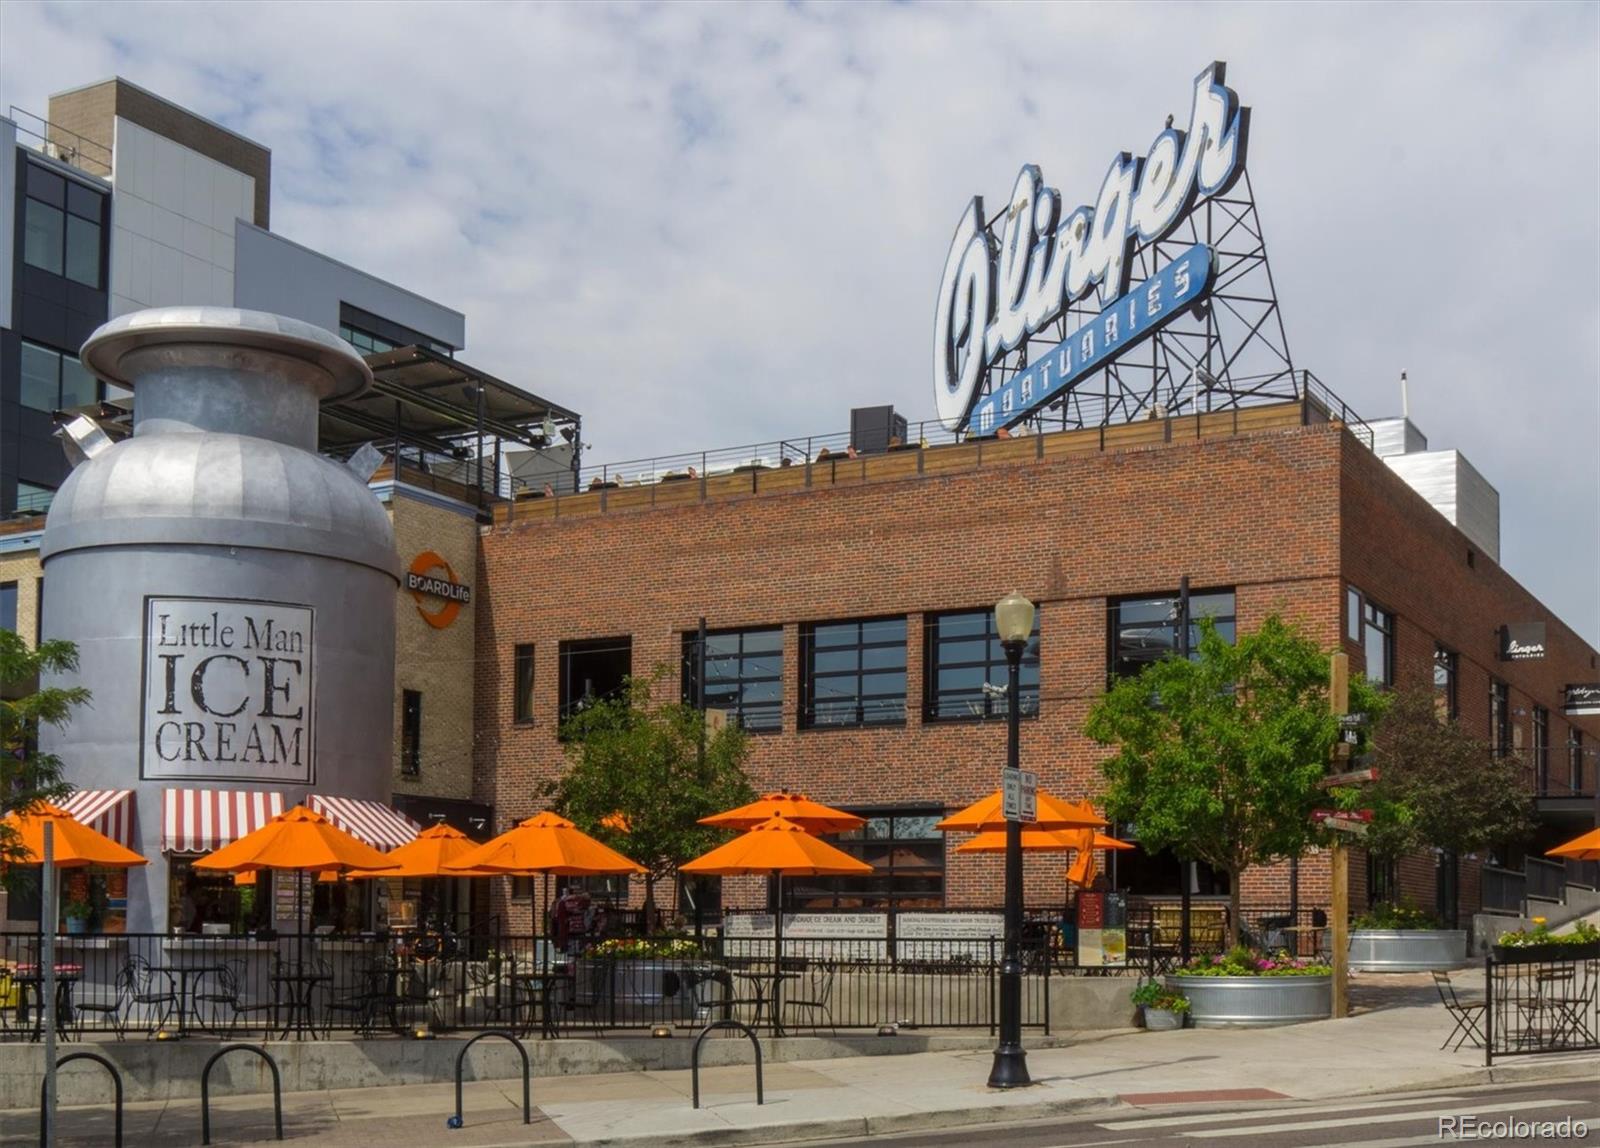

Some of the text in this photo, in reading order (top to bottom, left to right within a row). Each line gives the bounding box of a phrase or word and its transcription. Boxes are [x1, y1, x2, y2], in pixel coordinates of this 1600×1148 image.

[934, 60, 1250, 432] Olinger
[979, 259, 1192, 432] MORTUARIES
[158, 612, 304, 653] Little Man
[157, 654, 303, 721] ICE
[155, 721, 303, 766] CREAM
